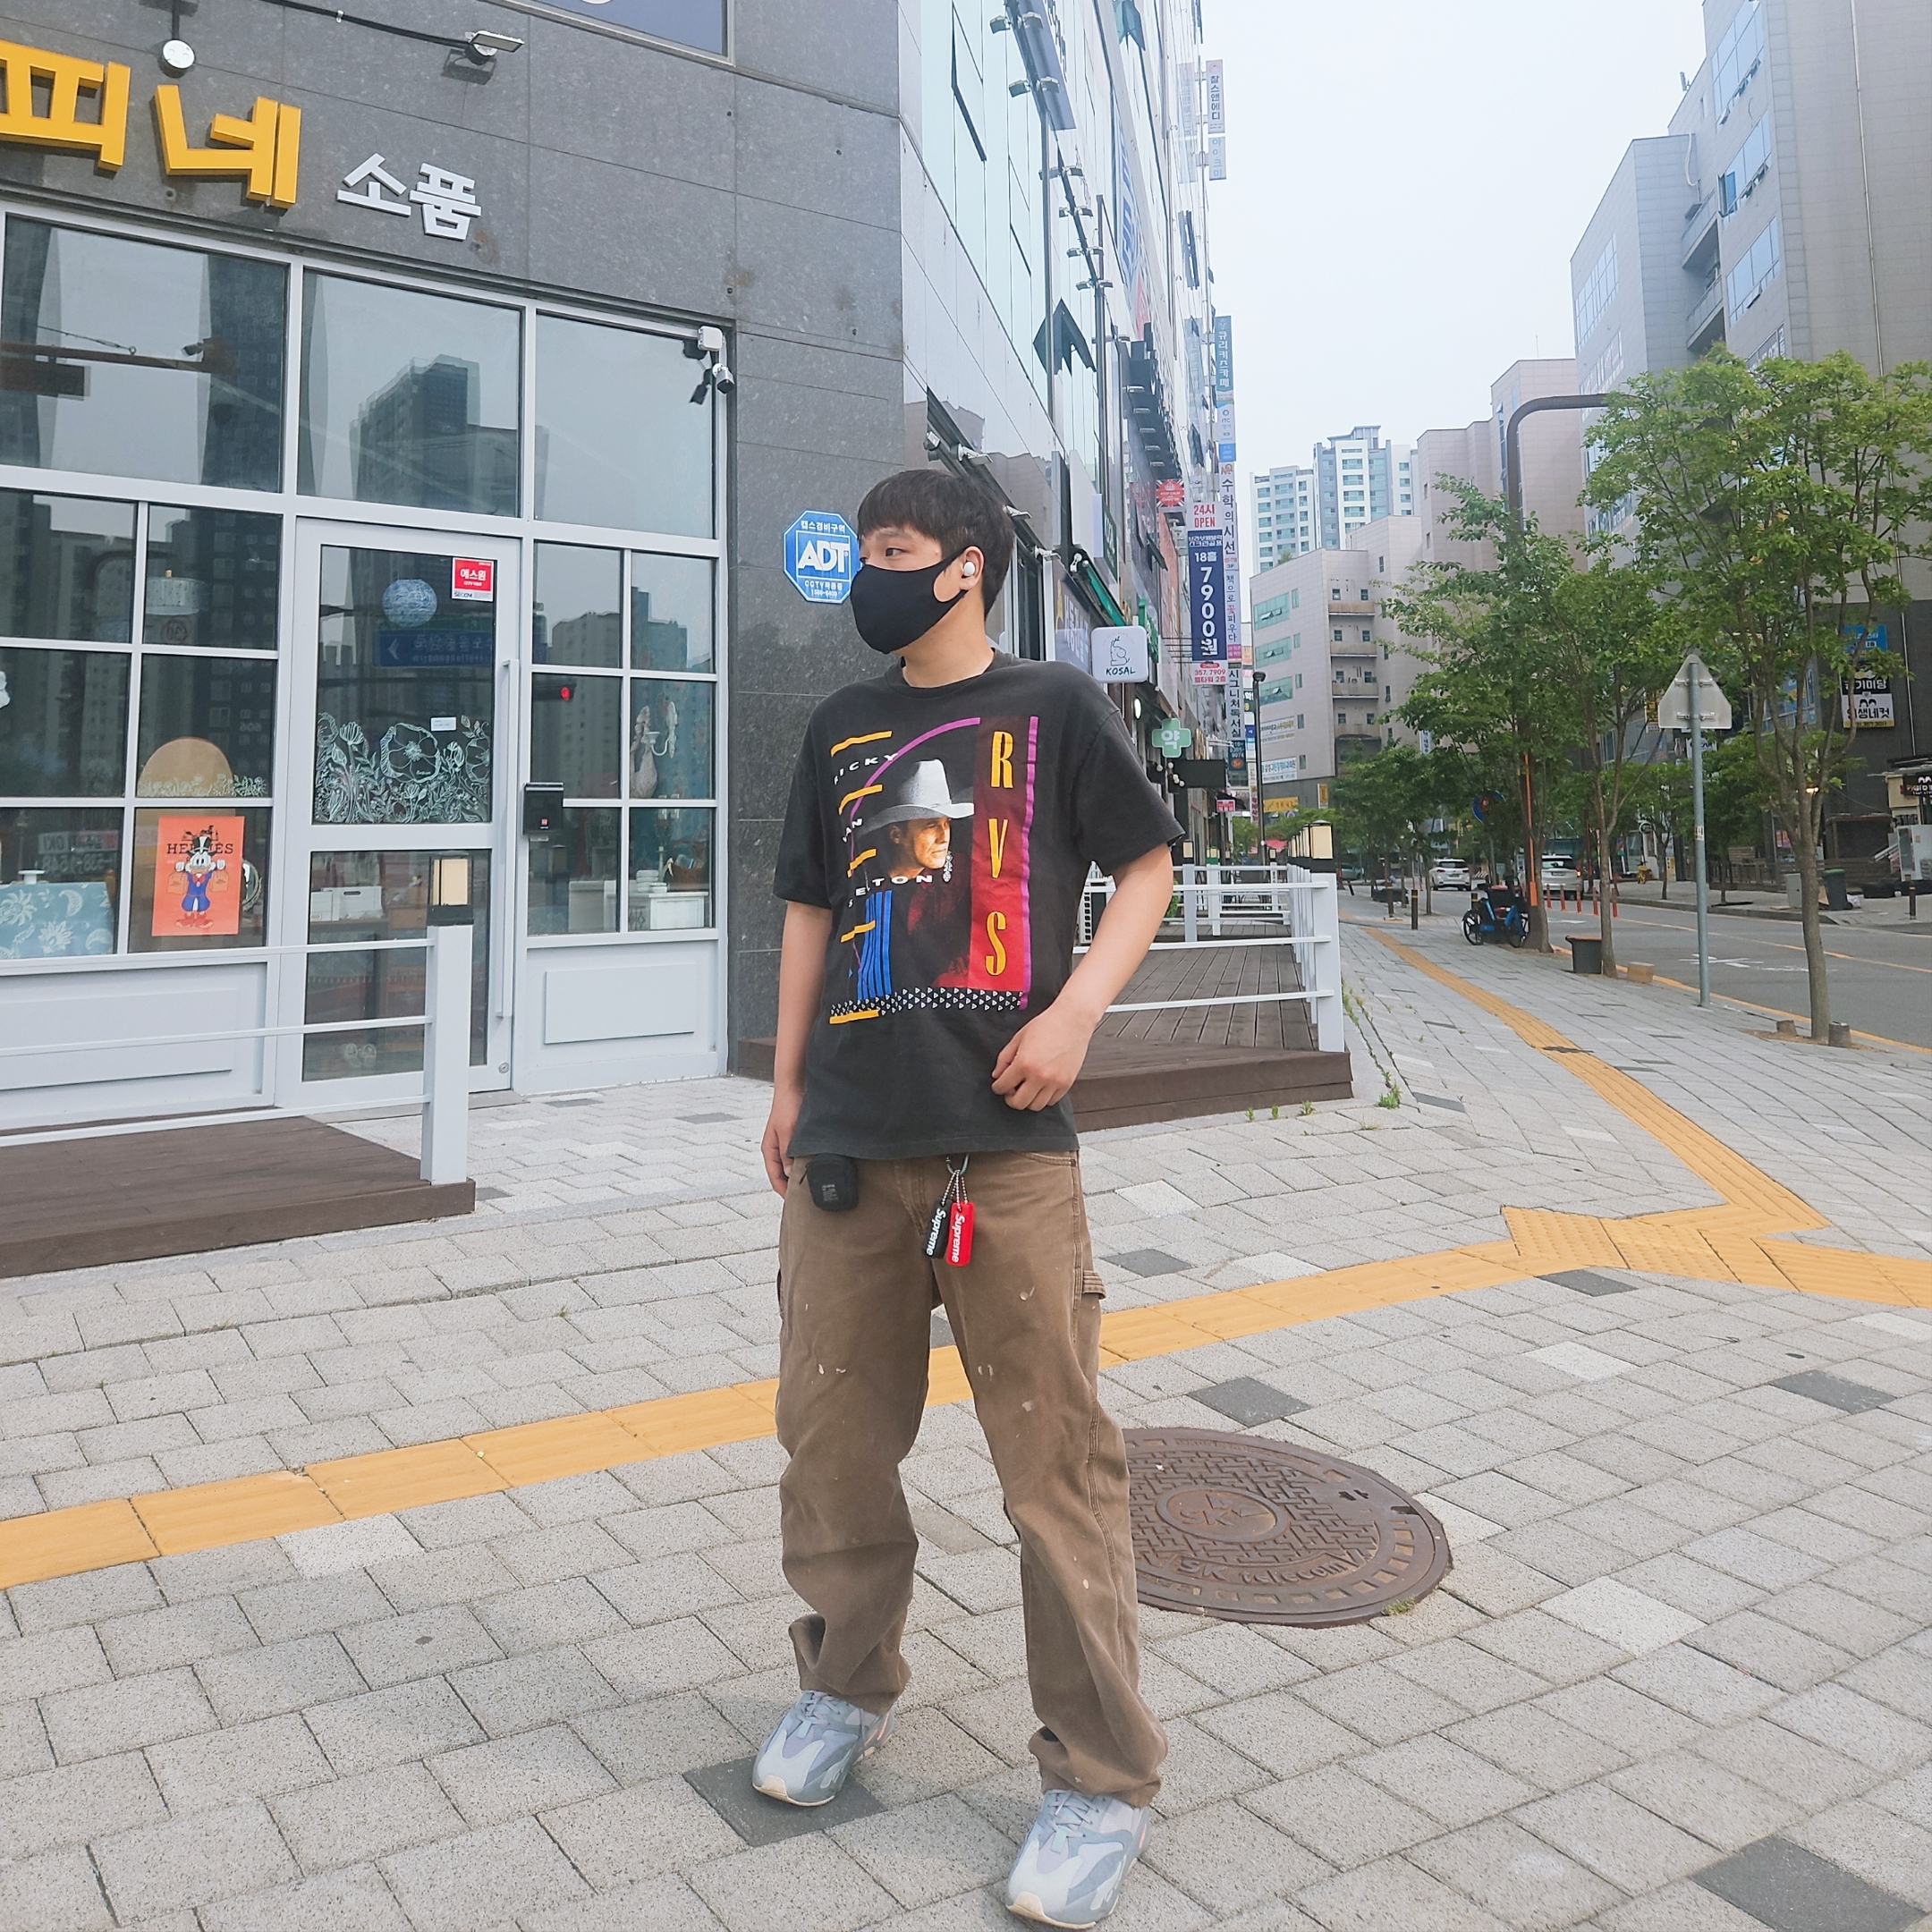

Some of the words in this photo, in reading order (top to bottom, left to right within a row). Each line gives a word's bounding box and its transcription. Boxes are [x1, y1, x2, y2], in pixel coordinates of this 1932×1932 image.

[336, 151, 483, 241] 소품
[1194, 504, 1215, 515] 24시
[1195, 517, 1216, 528] OPEN
[1221, 478, 1236, 555] 수학의시선
[798, 539, 850, 572] ADT
[1106, 666, 1137, 676] KOSAL
[927, 1208, 946, 1256] Supreme
[951, 1213, 965, 1263] Supreme
[1176, 1555, 1227, 1581] SK
[1239, 1560, 1349, 1585] telecom
